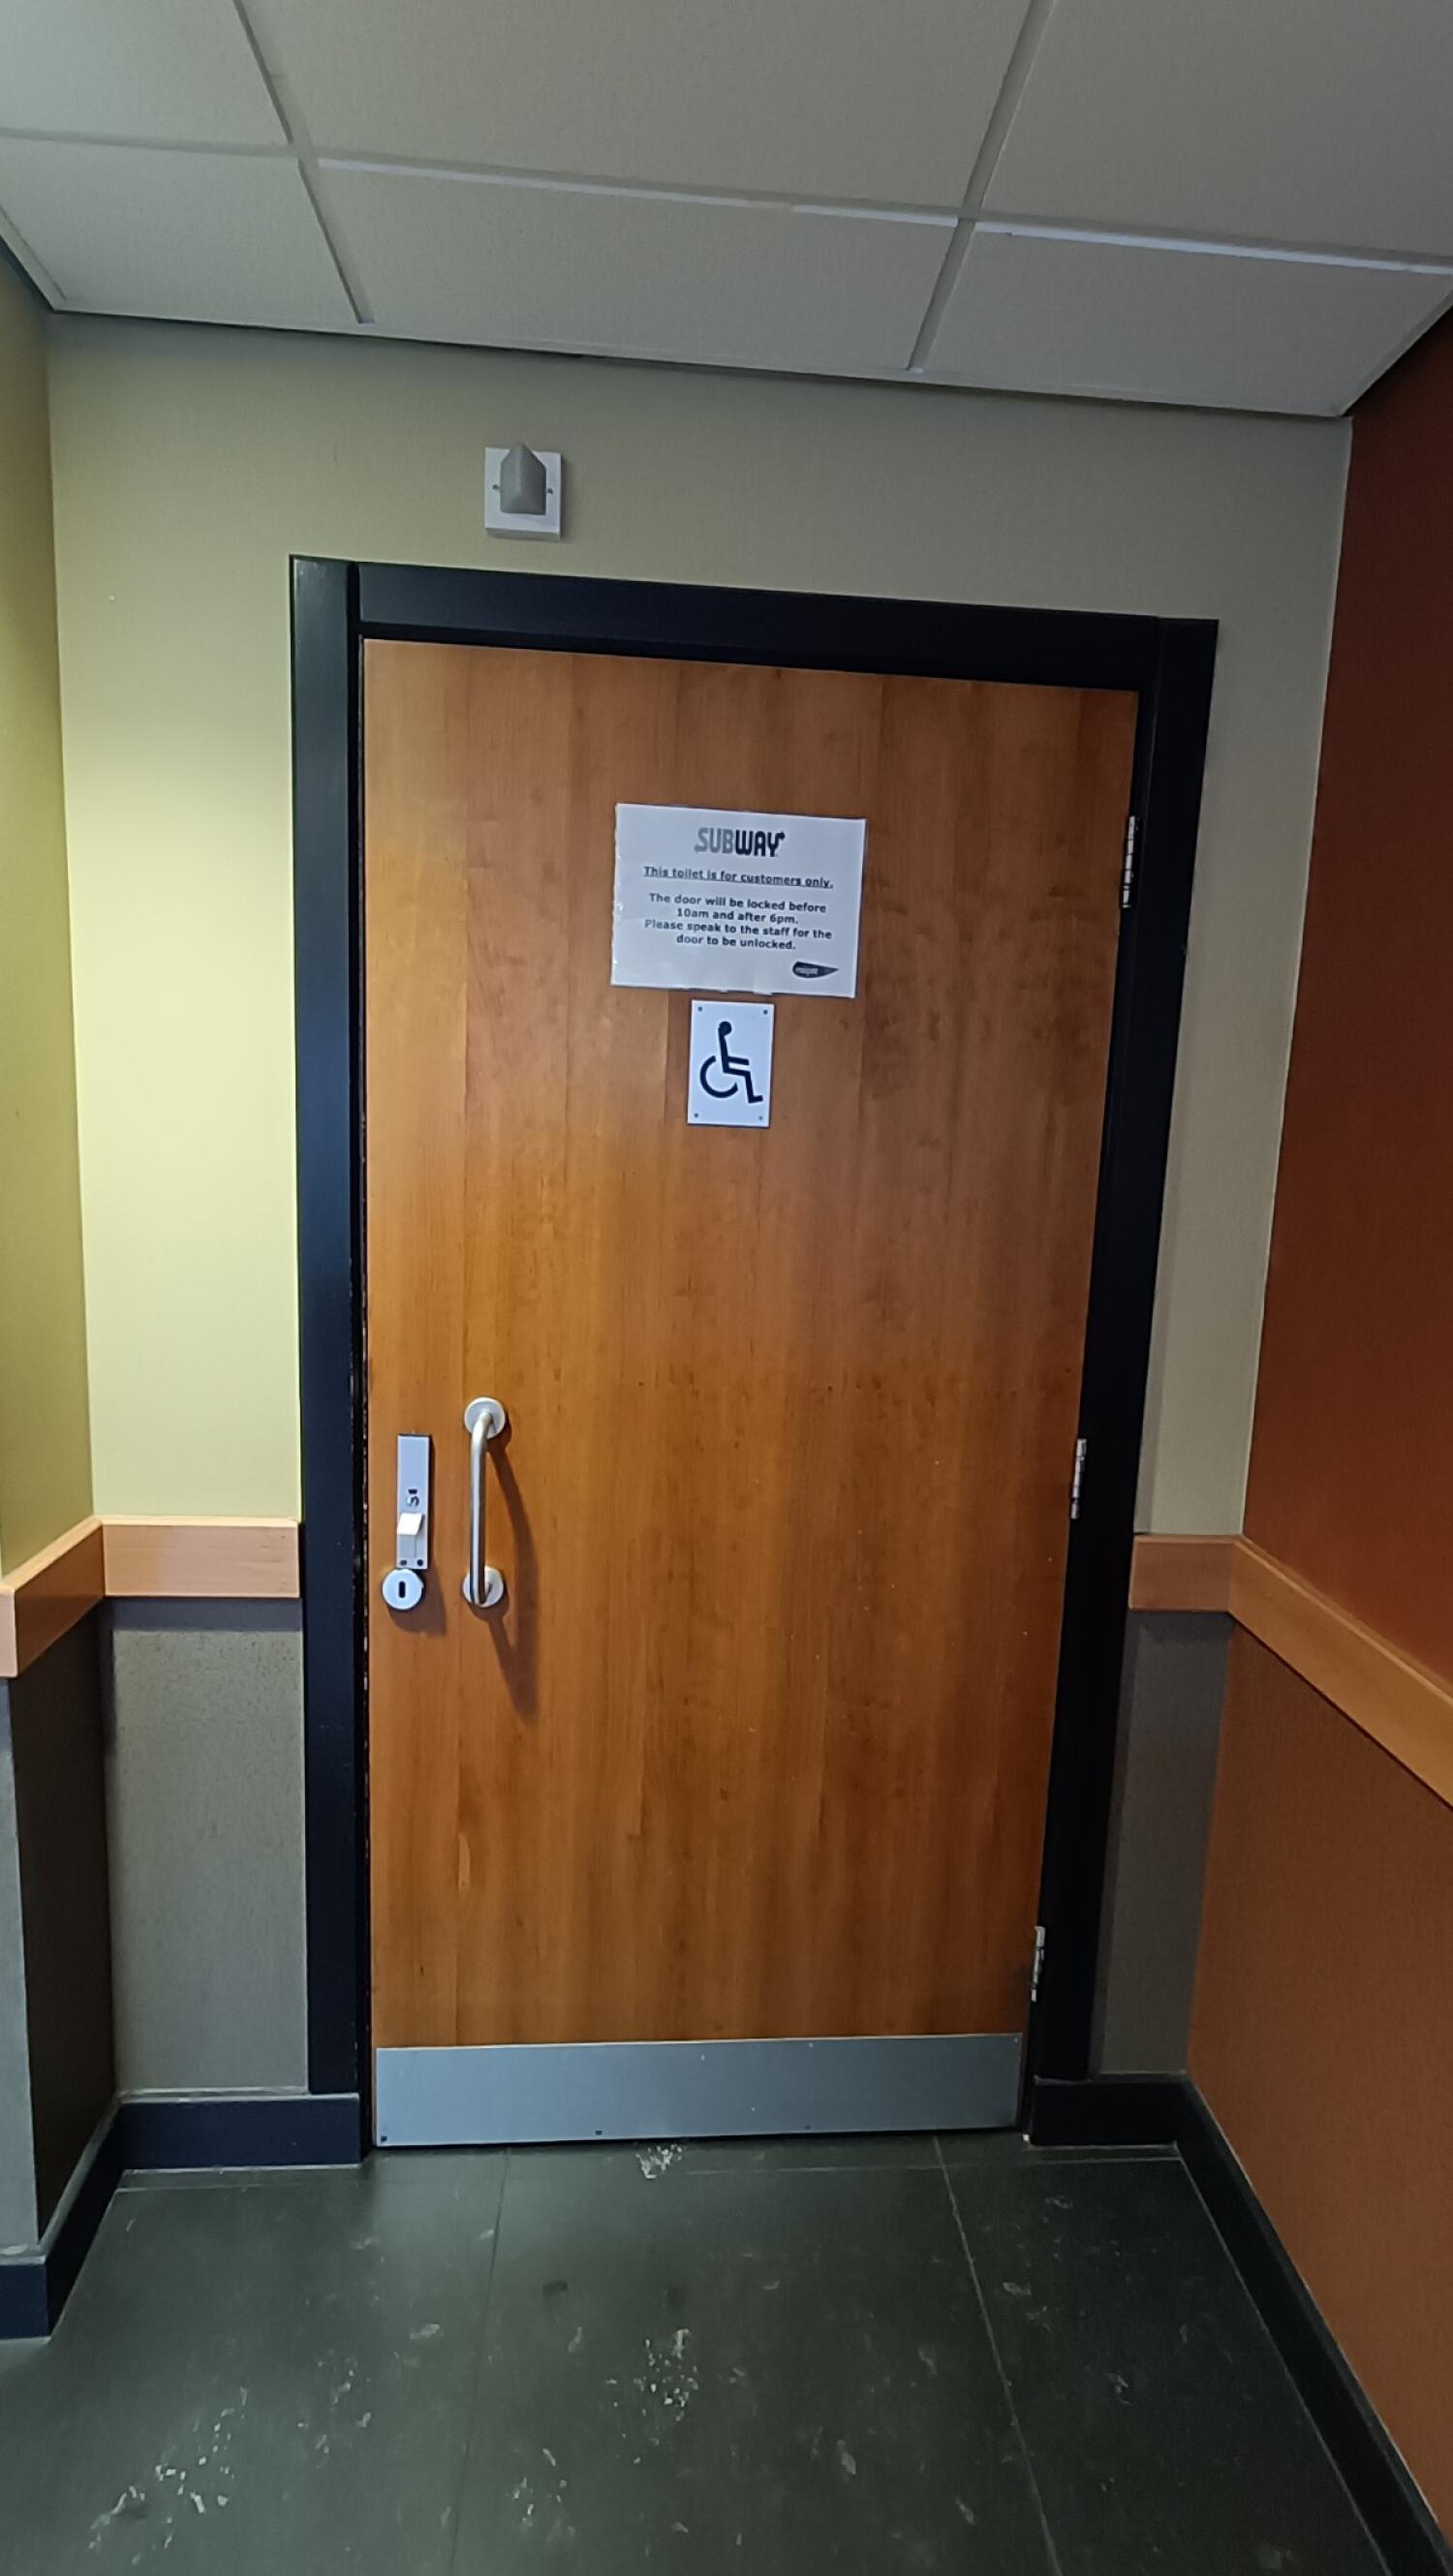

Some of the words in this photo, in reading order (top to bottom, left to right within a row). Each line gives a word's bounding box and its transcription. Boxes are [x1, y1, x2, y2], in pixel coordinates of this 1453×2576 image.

[695, 827, 786, 857] SUBWAY
[643, 867, 668, 877] This
[672, 868, 703, 879] toilet
[707, 870, 717, 880] is
[721, 871, 737, 881] for
[741, 874, 801, 886] customers
[805, 877, 833, 889] only.
[649, 892, 670, 903] The
[674, 894, 701, 905] door
[705, 896, 726, 906] will
[729, 898, 744, 907] be
[747, 899, 785, 910] locked
[788, 901, 826, 913] before
[677, 907, 709, 918] 10am
[712, 910, 734, 920] and
[738, 911, 766, 922] after
[770, 914, 799, 925] 6pm.
[644, 919, 683, 930] Please
[687, 923, 721, 933] speak
[725, 924, 736, 934] to
[740, 925, 759, 935] the
[762, 927, 789, 936] staff
[793, 928, 810, 937] for
[813, 930, 832, 939] the
[676, 934, 703, 943] door
[706, 935, 719, 945] to
[722, 936, 736, 946] be
[740, 937, 796, 950] unlocked.
